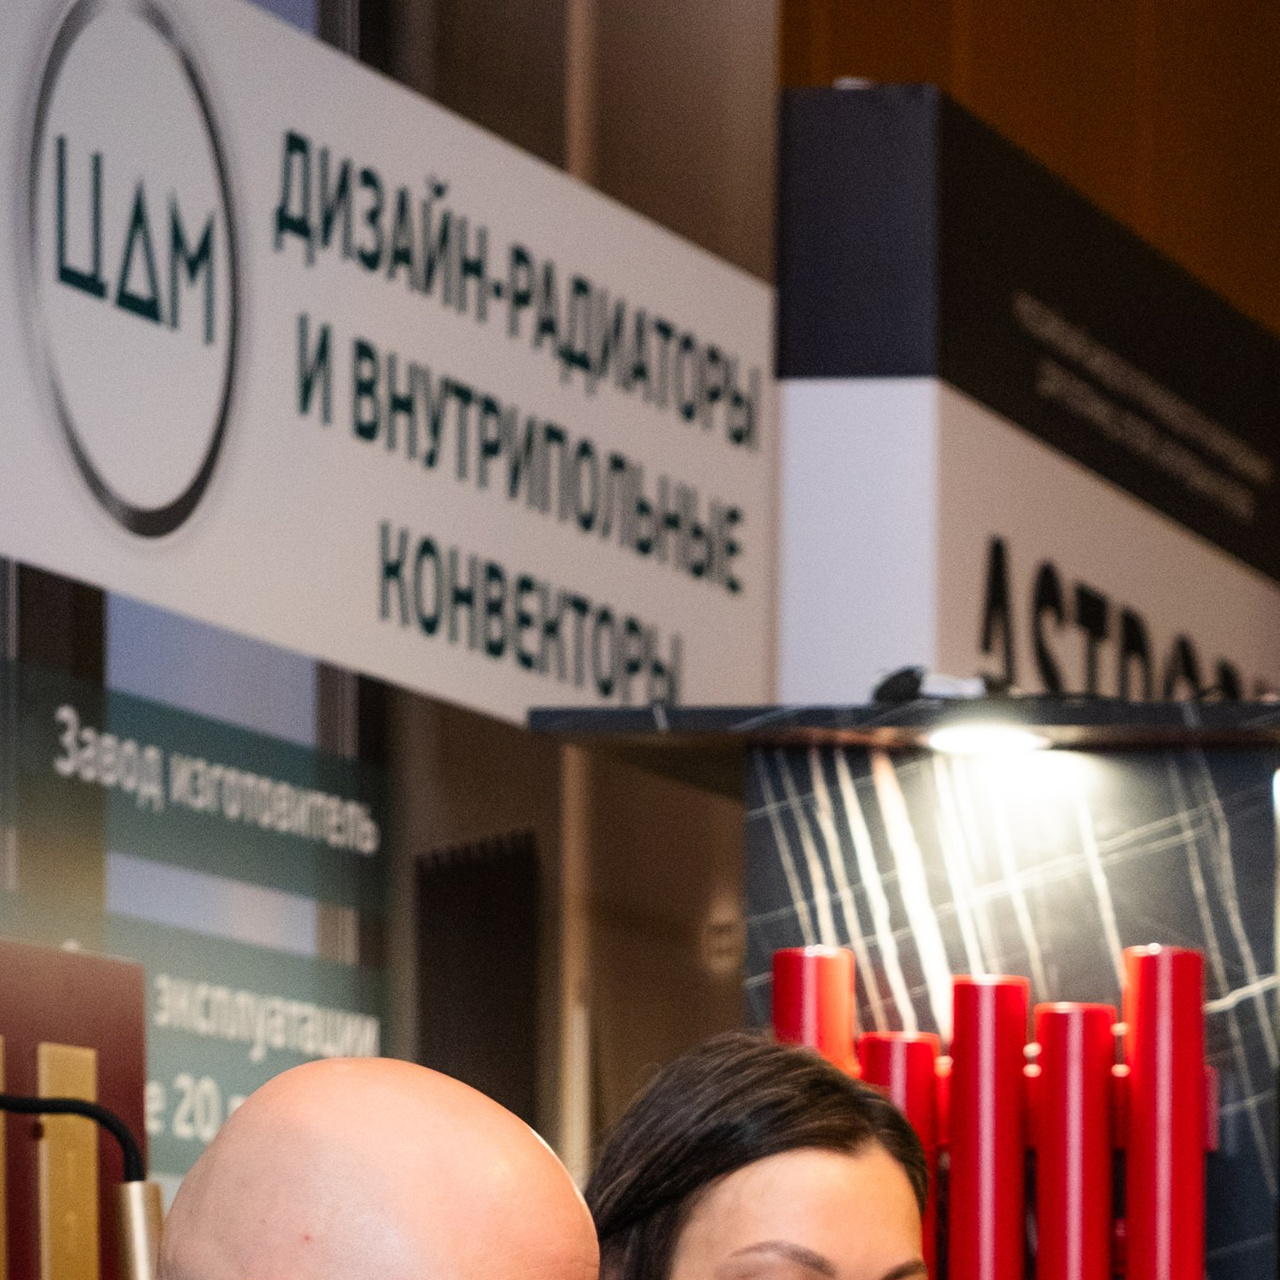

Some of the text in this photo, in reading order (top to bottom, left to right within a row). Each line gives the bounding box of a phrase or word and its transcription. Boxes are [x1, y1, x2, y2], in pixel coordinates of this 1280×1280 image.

[274, 129, 761, 451] ДИЗАЙН-РАДИАТОРЫ
[298, 312, 743, 596] И ВНУТРИПОЛЬНЫЕ
[378, 520, 683, 708] КОНВЕКТОРЫ
[53, 704, 165, 814] Завод
[172, 1071, 223, 1143] 20
